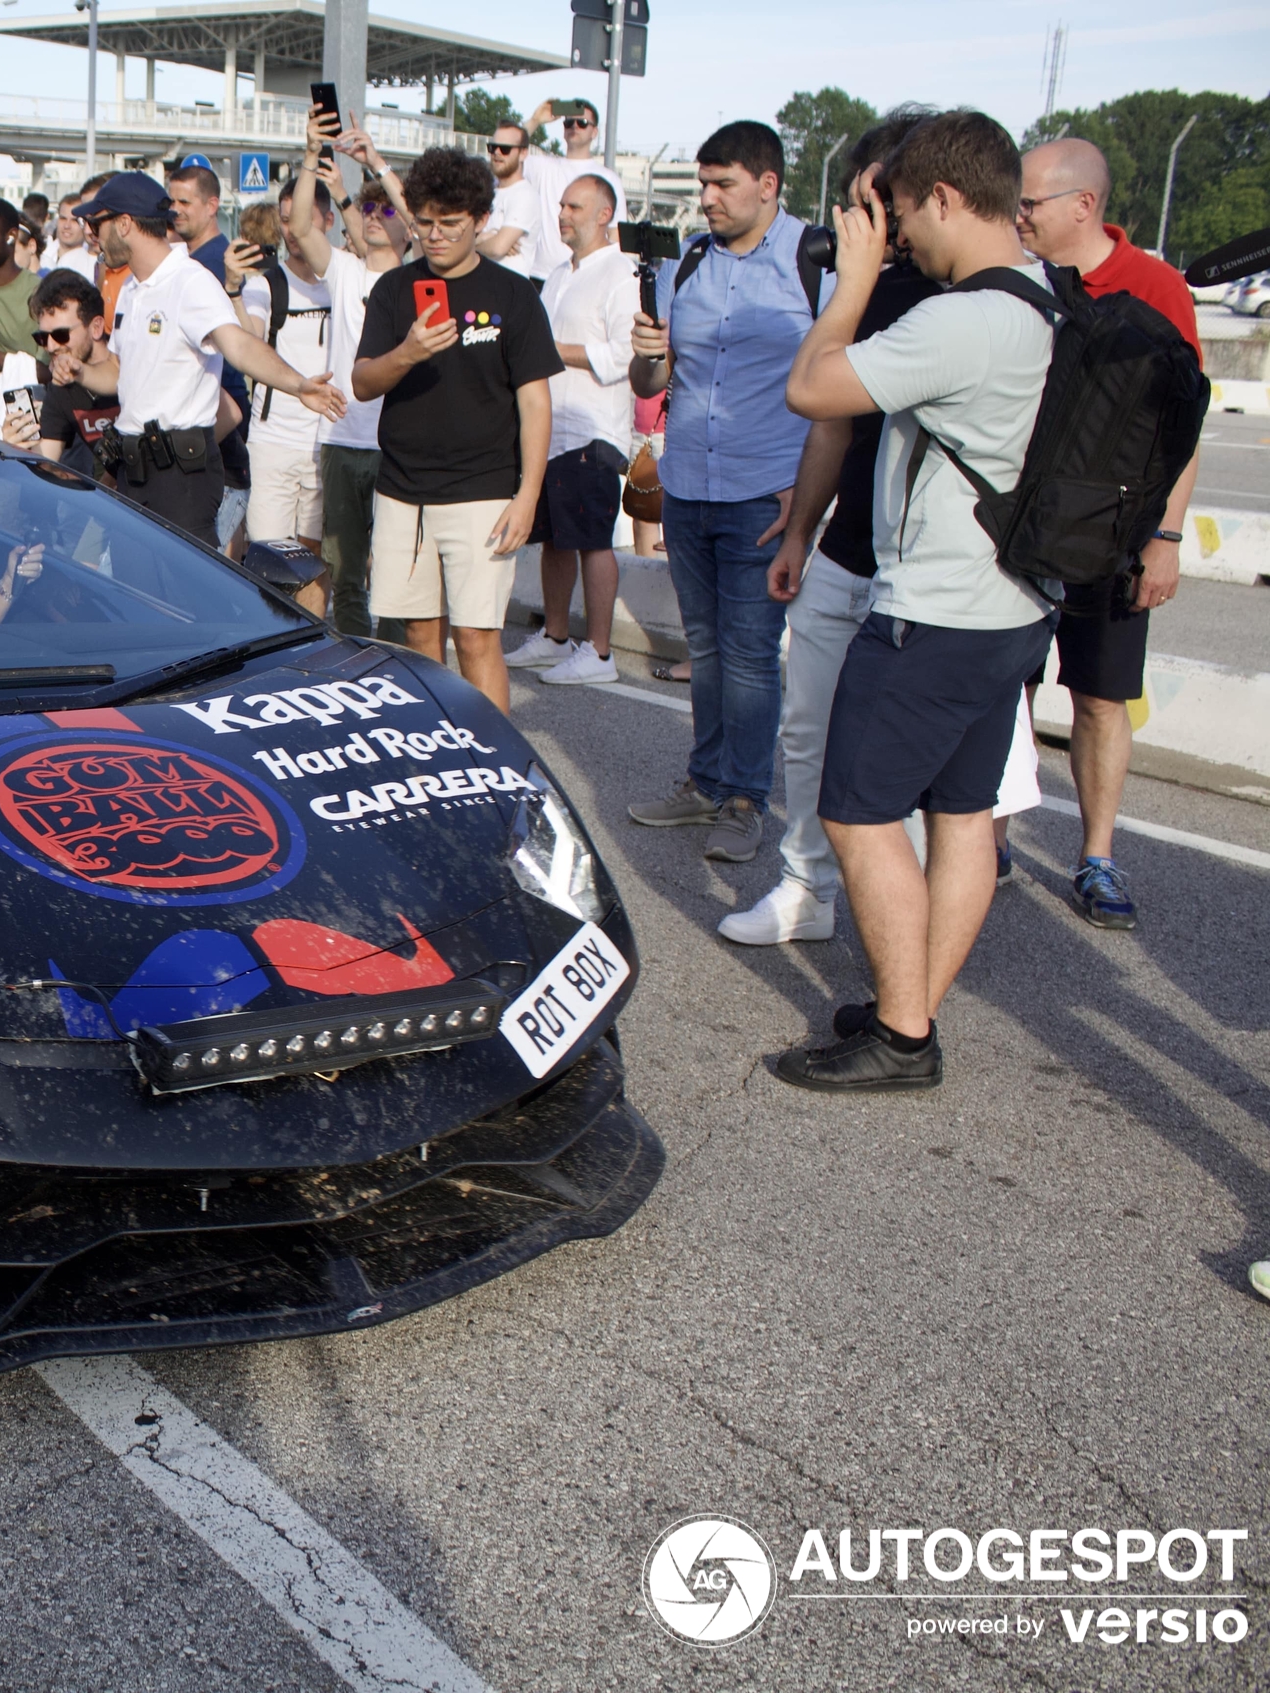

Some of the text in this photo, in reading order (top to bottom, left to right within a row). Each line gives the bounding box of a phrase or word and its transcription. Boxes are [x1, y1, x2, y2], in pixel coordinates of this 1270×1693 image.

[169, 676, 425, 735] Kappa
[252, 720, 494, 780] Hard Rock
[28, 780, 258, 838] BALL
[309, 766, 538, 821] CARRERA
[331, 807, 431, 833] EYEWEAR
[441, 796, 496, 810] SINCE
[516, 983, 577, 1056] ROT
